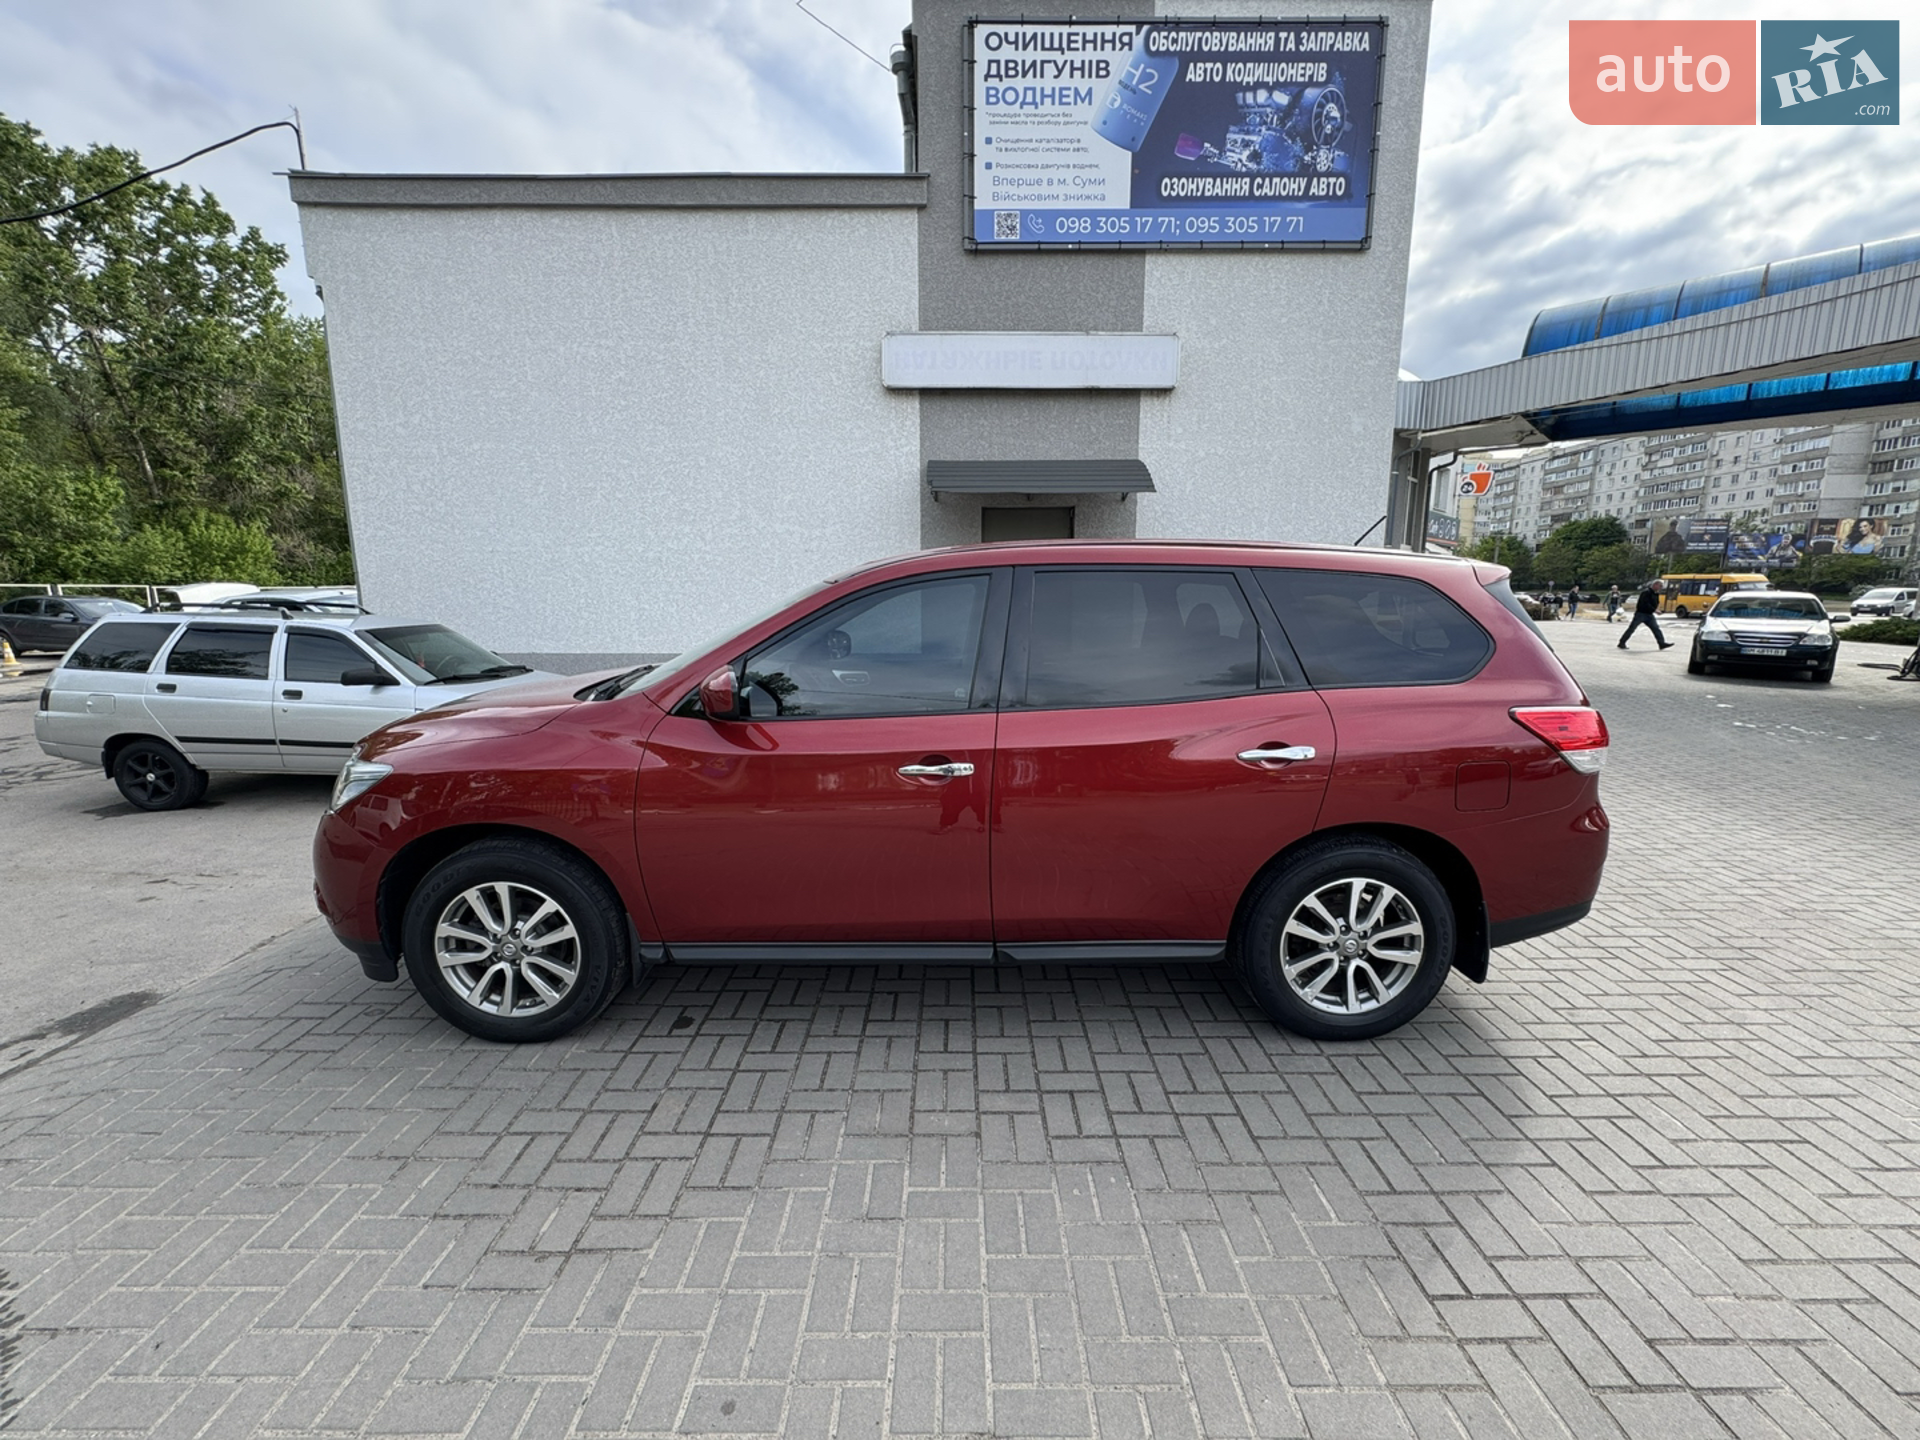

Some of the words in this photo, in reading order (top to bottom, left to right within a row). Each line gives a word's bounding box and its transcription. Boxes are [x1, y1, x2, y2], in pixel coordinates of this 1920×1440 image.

[984, 31, 1133, 55] ОЧИЩЕННЯ
[1149, 31, 1275, 52] ОБСЛУГОВУВАННЯ
[1278, 31, 1296, 52] ТА
[1299, 31, 1370, 52] ЗАПРАВКА
[984, 59, 1111, 82] ДВИГУНІВ
[1121, 57, 1159, 95] H2
[1186, 62, 1223, 83] АВТО
[1226, 62, 1328, 86] КОДИЦІОНЕРІВ
[985, 86, 1092, 110] ВОДНЕМ
[995, 136, 1033, 144] Очищення
[1035, 137, 1081, 145] каталізаторів
[992, 175, 1043, 188] Вперше
[1047, 178, 1054, 186] в
[1057, 178, 1069, 186] м.
[1073, 175, 1106, 188] Суми
[1160, 177, 1250, 197] ОЗОНУВАННЯ
[1253, 177, 1306, 196] САЛОНУ
[1309, 177, 1346, 196] АВТО
[992, 191, 1060, 202] Військовим
[1062, 193, 1106, 202] знижка
[1055, 216, 1091, 233] 098
[1096, 216, 1130, 233] 305
[1135, 216, 1153, 233] 17
[1185, 216, 1220, 233] 095
[1224, 216, 1258, 233] 305
[1263, 216, 1281, 233] 17
[1284, 216, 1304, 233] 71
